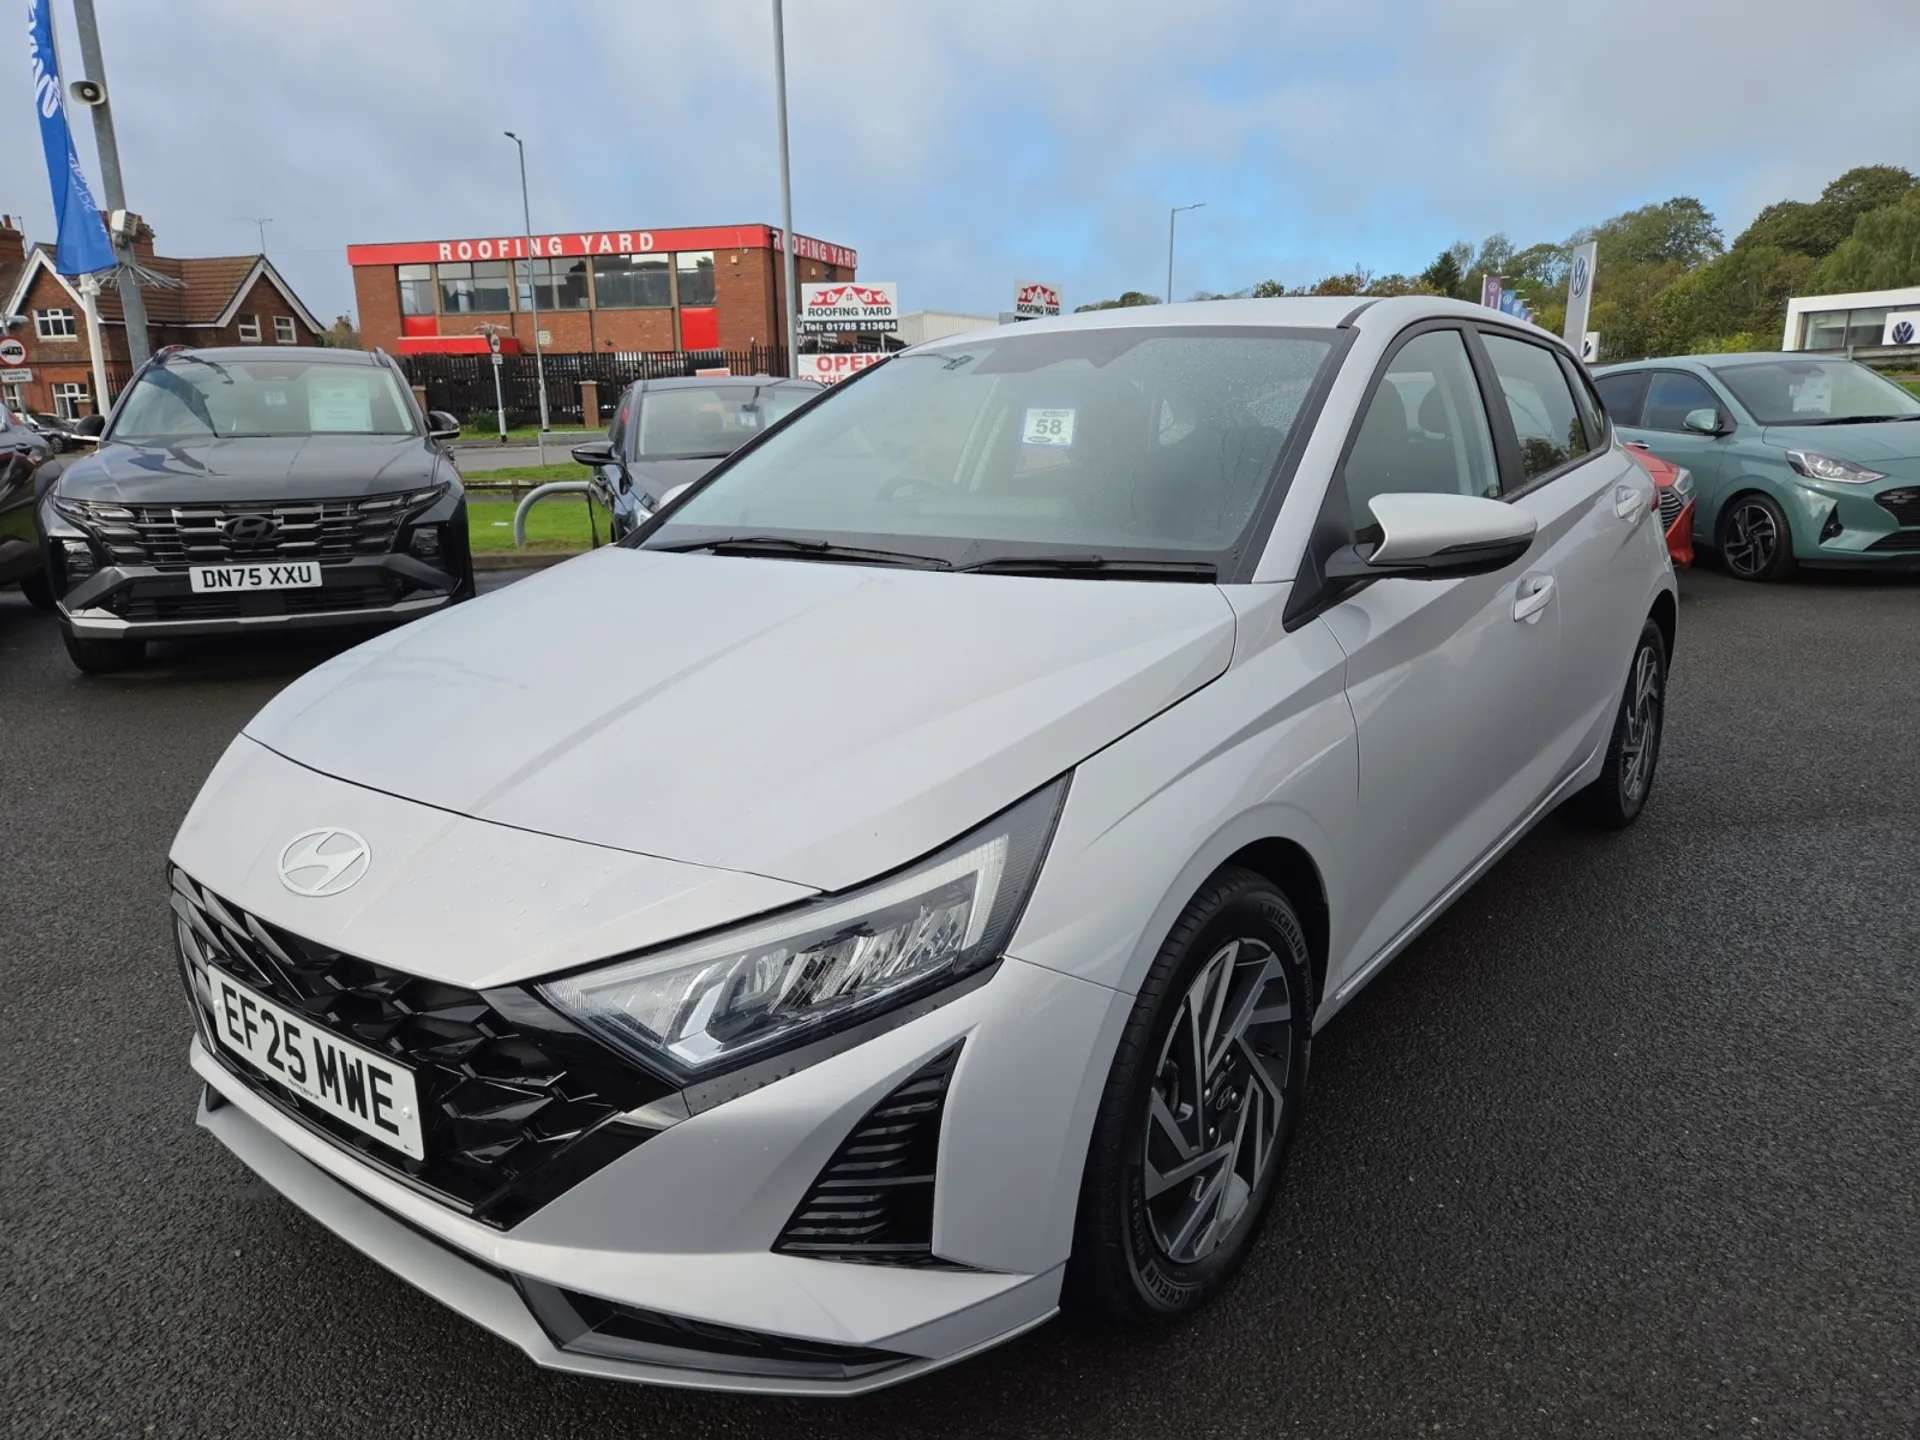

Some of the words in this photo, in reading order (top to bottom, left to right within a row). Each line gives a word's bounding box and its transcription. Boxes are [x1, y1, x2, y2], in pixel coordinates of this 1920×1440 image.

[439, 236, 563, 261] ROOFING
[580, 232, 654, 255] YARD
[772, 229, 828, 260] ROFING
[831, 245, 857, 269] YARD
[808, 307, 859, 317] ROOFING
[862, 307, 892, 316] YARD
[1016, 304, 1043, 315] ROOFING
[1045, 306, 1060, 316] YARD
[805, 322, 824, 332] Tel:
[1036, 419, 1062, 435] 58
[201, 568, 262, 588] DN75
[268, 565, 312, 585] XXU
[221, 981, 308, 1085] EF25
[313, 1036, 400, 1137] MWE
